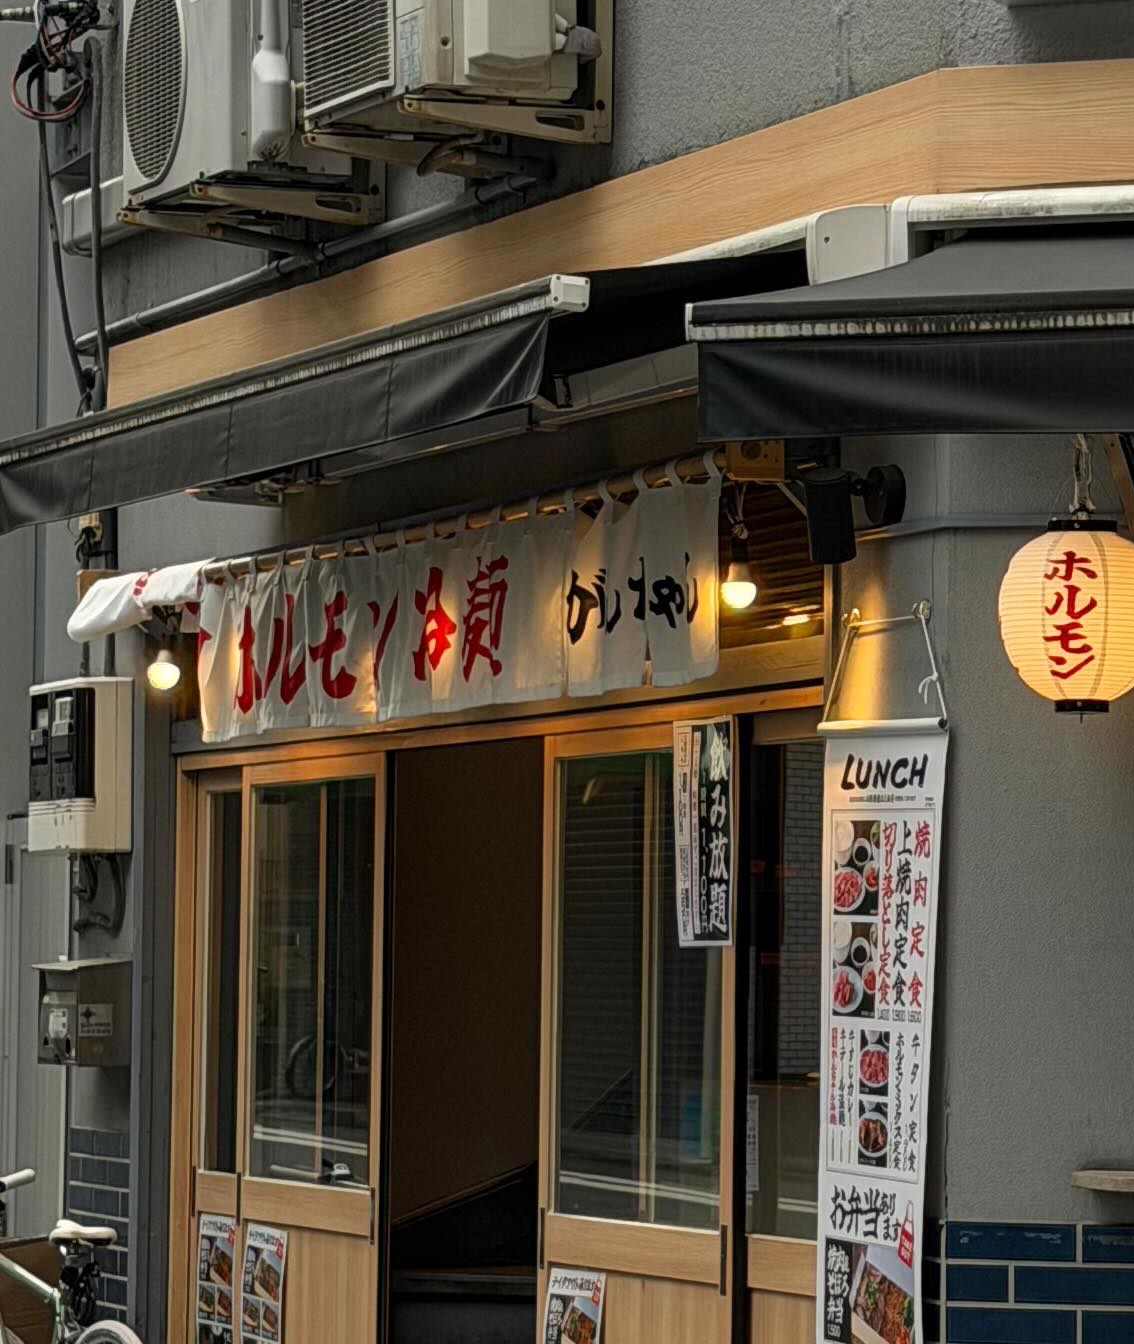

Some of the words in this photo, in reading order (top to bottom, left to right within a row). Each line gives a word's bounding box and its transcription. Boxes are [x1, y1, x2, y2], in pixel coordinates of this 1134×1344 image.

[1043, 550, 1099, 680] ホルモン
[708, 730, 729, 934] 飲み放題
[841, 753, 929, 791] LUNCH
[877, 821, 897, 1006] 切り落とし定食
[891, 820, 913, 1007] 上焼肉定食
[908, 820, 931, 1009] 焼肉定食
[830, 1184, 881, 1239] お弁当
[881, 1191, 897, 1217] あり
